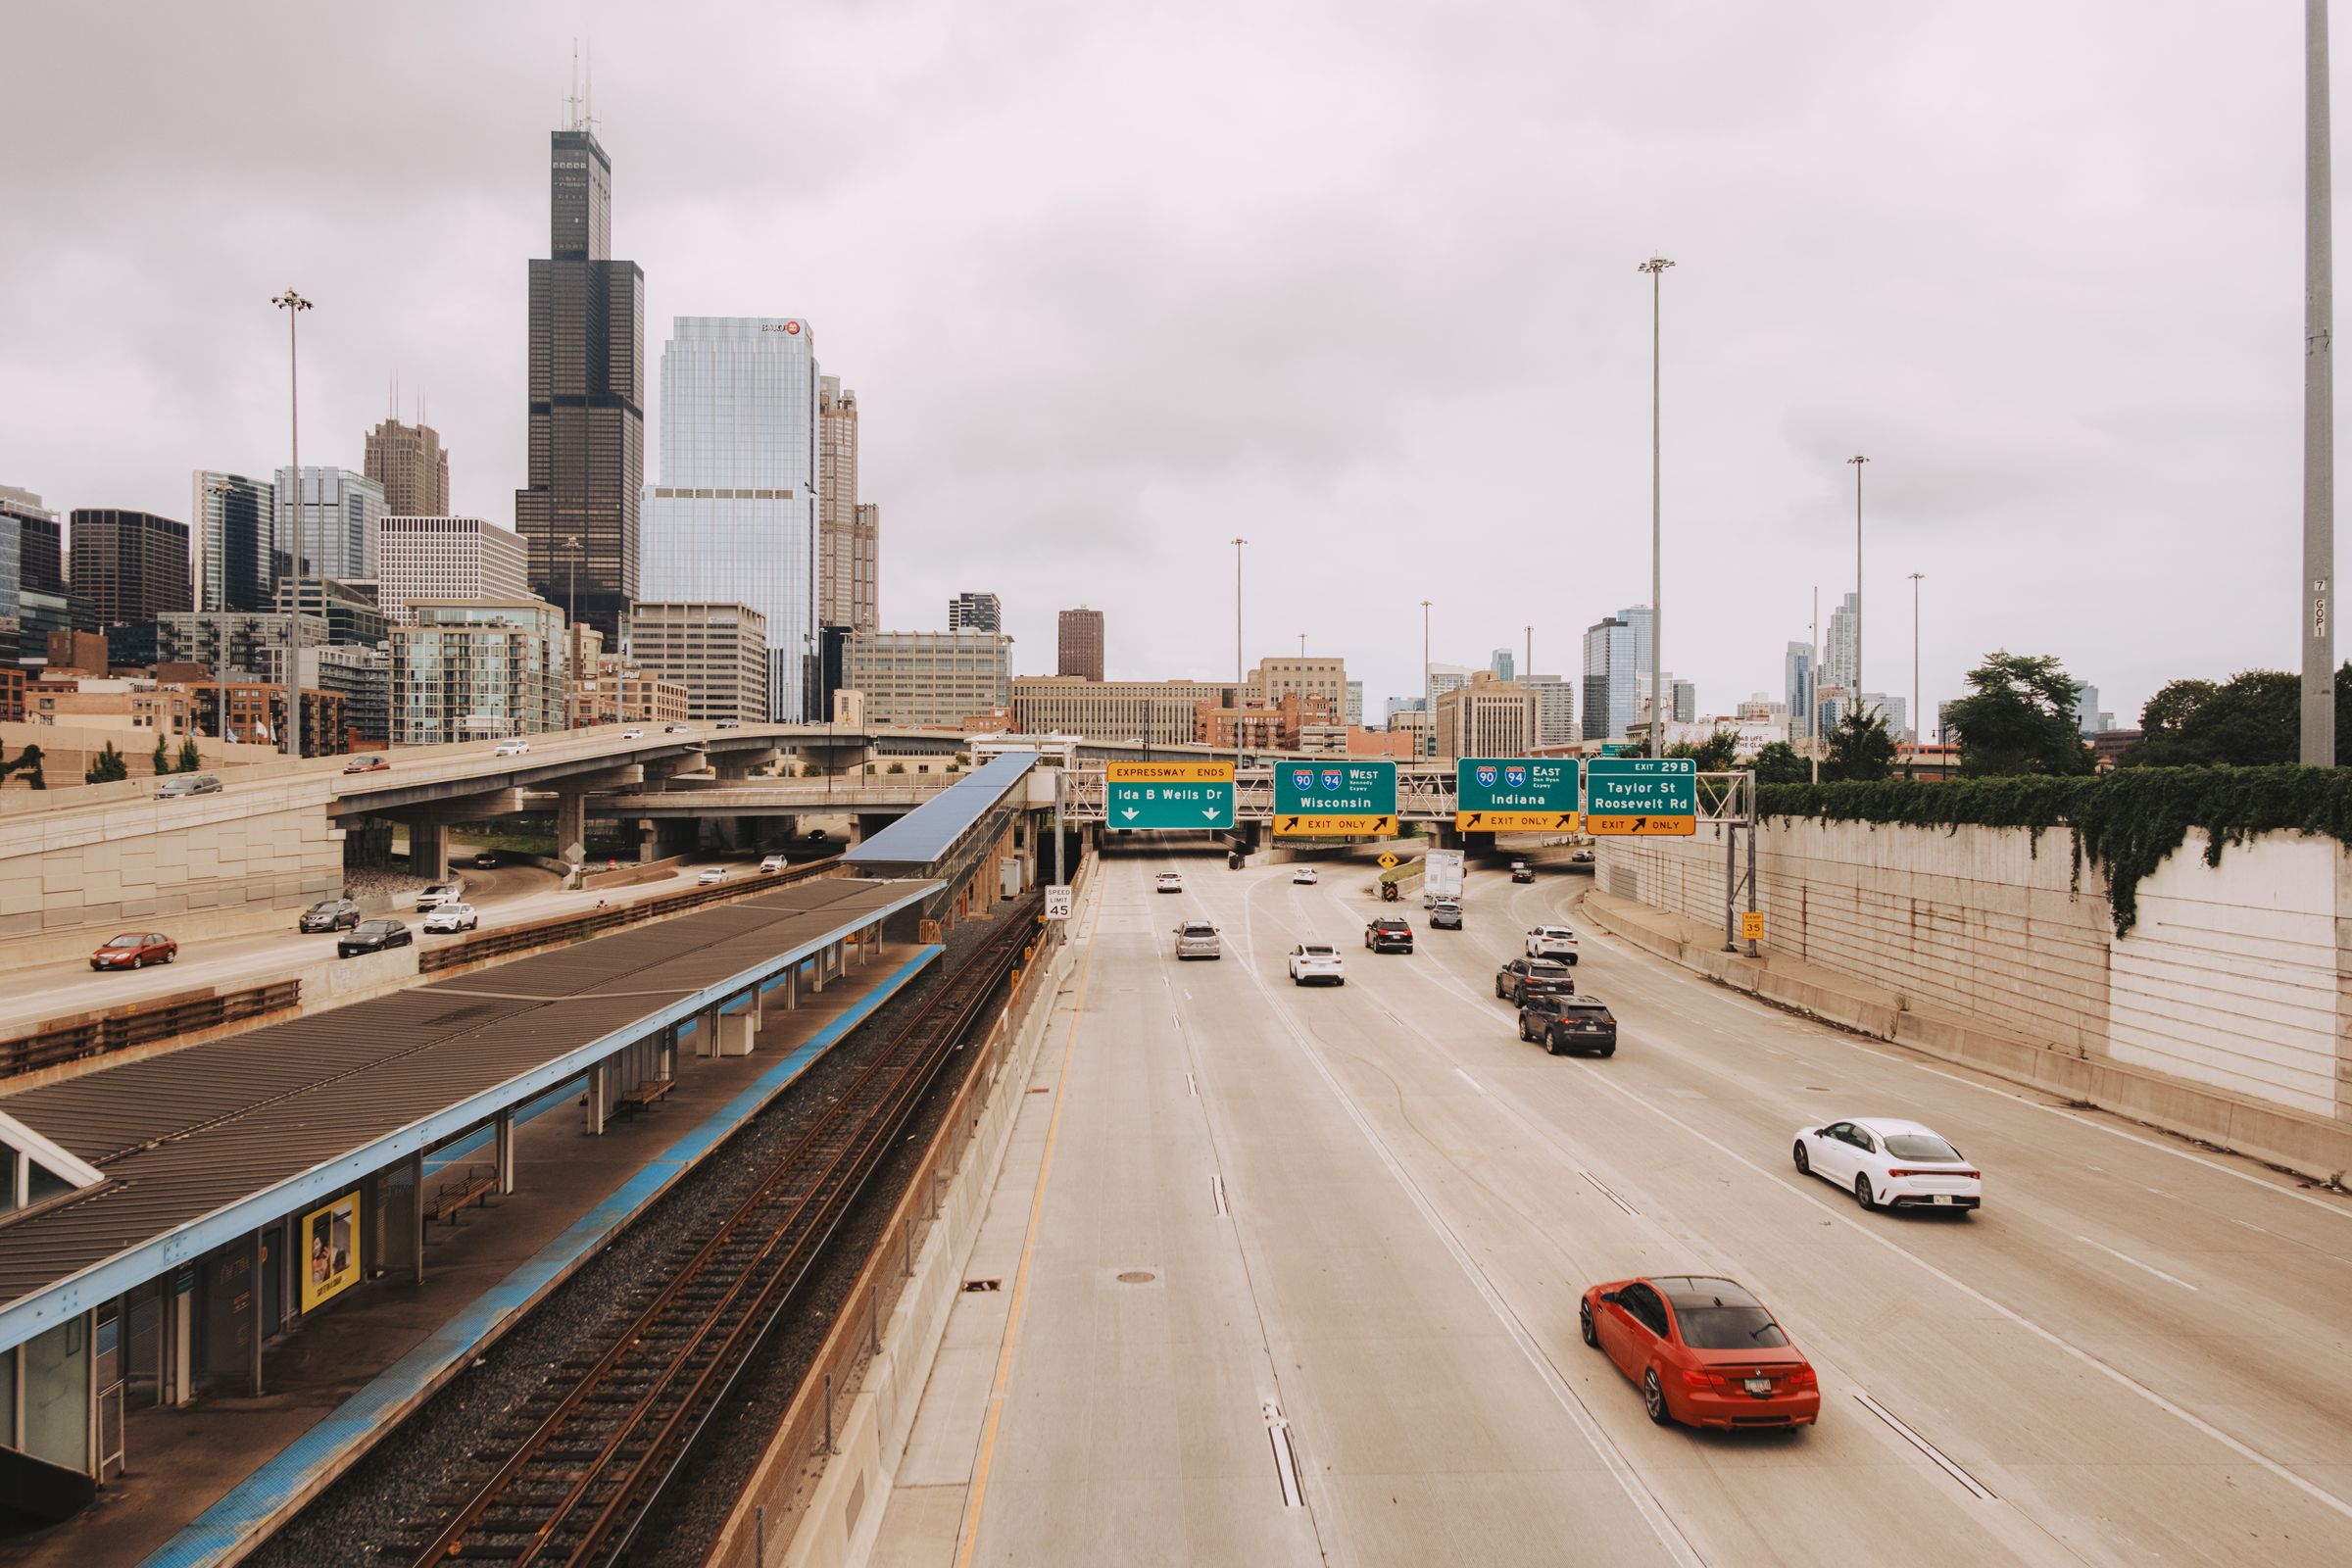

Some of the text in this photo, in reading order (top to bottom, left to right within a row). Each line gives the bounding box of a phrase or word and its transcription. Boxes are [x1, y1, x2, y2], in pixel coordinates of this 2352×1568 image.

[2316, 580, 2324, 590] 7
[1197, 768, 1225, 777] ENDS
[1296, 769, 1379, 786] 90 94 WEST
[1480, 766, 1561, 783] 90 94 EAST
[1607, 782, 1676, 796] Taylor St
[1118, 789, 1223, 800] Ida B Wells Dr
[1492, 794, 1545, 805] Indiana
[1300, 797, 1371, 808] Wisconsin
[1594, 798, 1688, 809] Roosevelt Rd
[1307, 820, 1366, 829] EXIT ONLY
[1491, 816, 1514, 825] EXIT
[1601, 820, 1625, 829] EXIT
[1050, 906, 1068, 915] 45
[1747, 923, 1761, 932] 35
